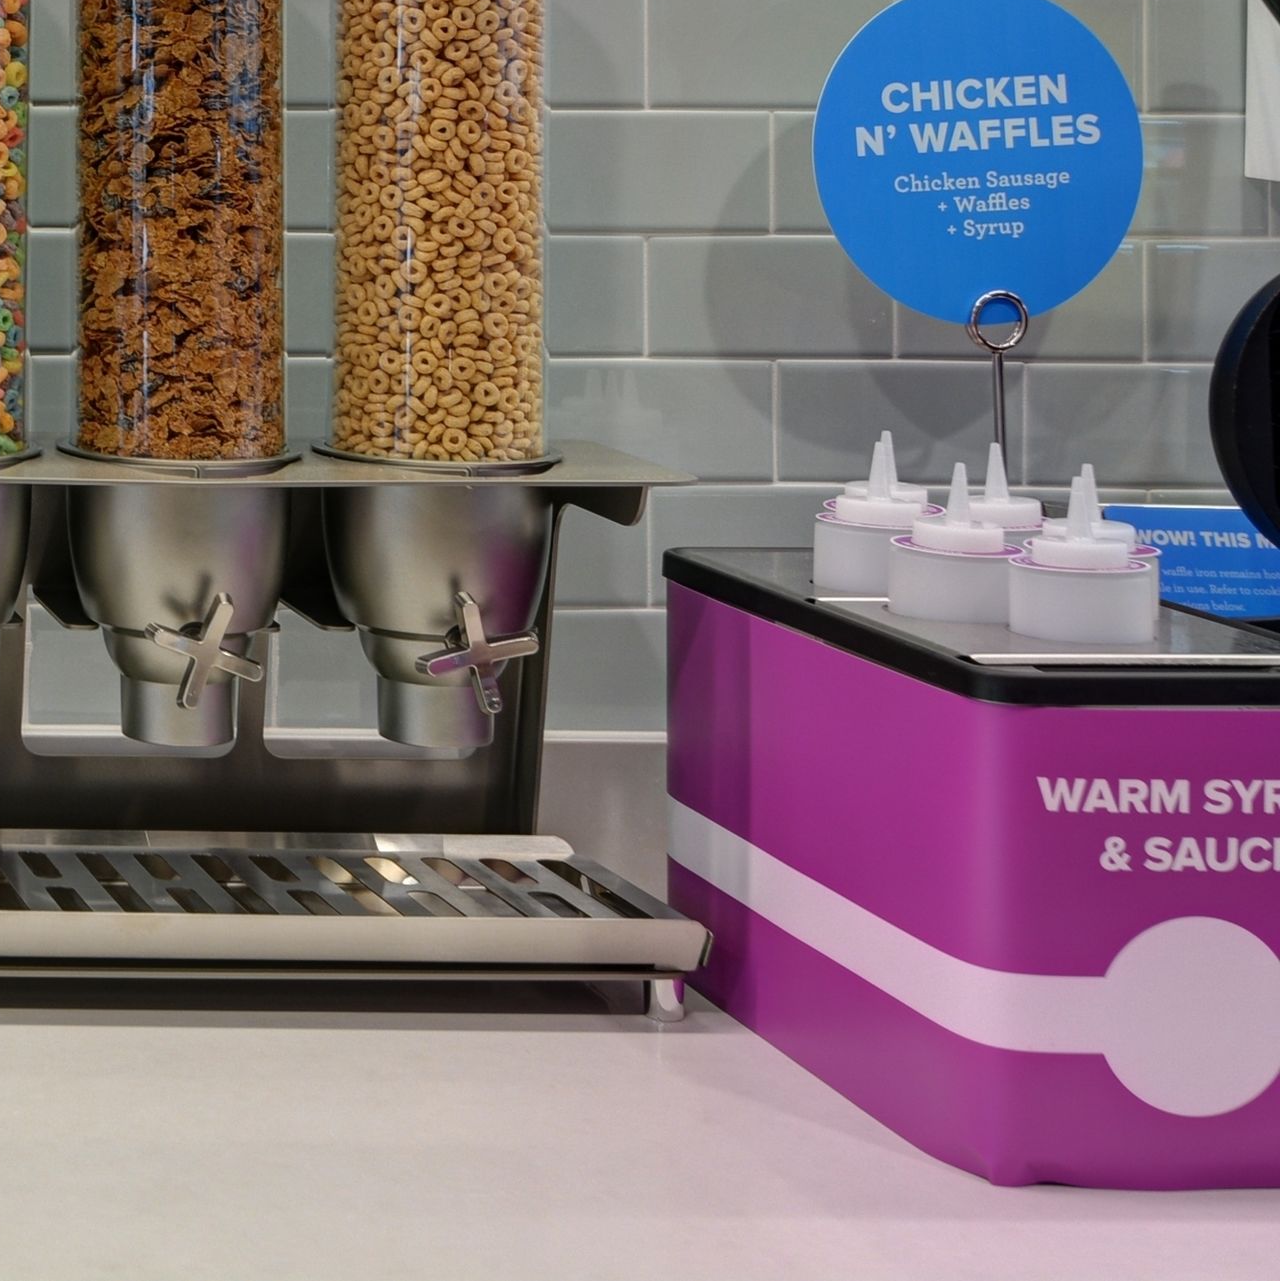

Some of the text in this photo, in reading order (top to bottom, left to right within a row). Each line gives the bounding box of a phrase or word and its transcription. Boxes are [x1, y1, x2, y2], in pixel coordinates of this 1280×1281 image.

[880, 73, 1069, 115] CHICKEN
[908, 113, 1103, 154] WAFFLES
[893, 170, 1071, 194] Chicken Sausage
[937, 191, 1031, 214] + Waffles
[946, 218, 1025, 241] + Syrup
[1199, 531, 1251, 548] THIS
[1162, 565, 1193, 577] waffle
[1195, 568, 1217, 578] iron
[1219, 570, 1262, 579] remains
[1173, 583, 1186, 593] in
[1209, 584, 1238, 595] Refer
[1239, 586, 1252, 596] to
[1036, 776, 1190, 814] WARM
[1099, 835, 1132, 872] &
